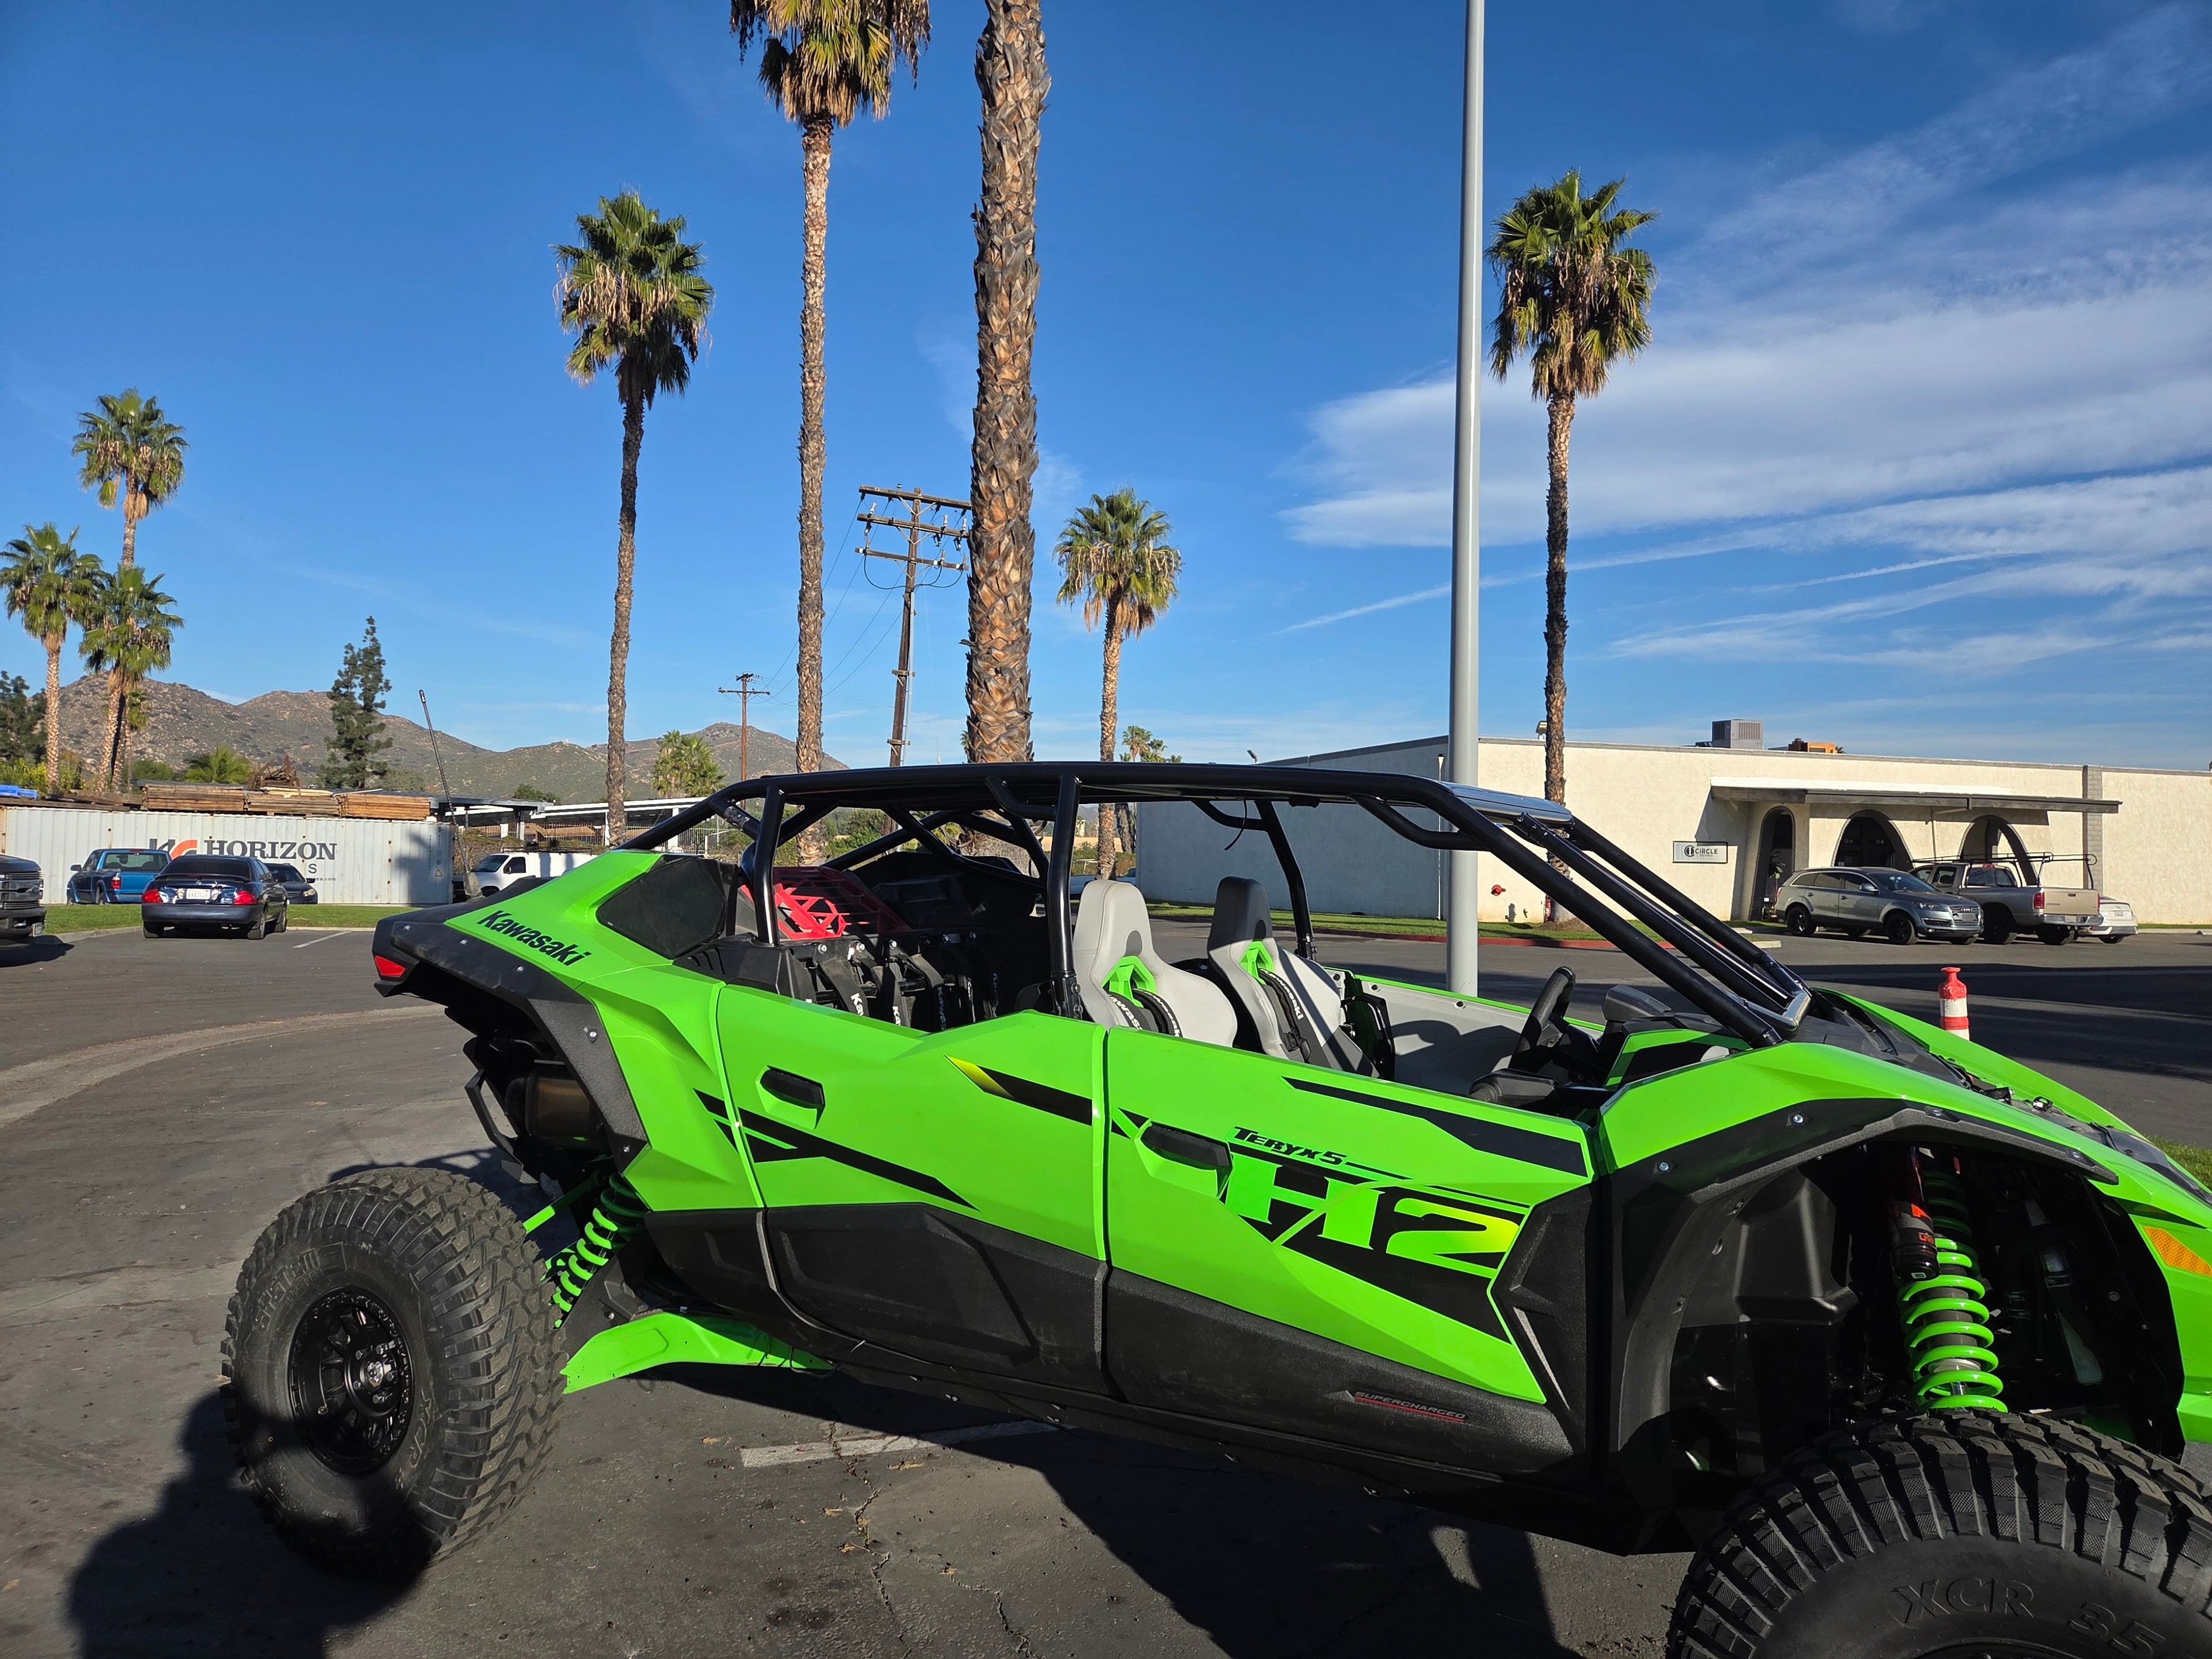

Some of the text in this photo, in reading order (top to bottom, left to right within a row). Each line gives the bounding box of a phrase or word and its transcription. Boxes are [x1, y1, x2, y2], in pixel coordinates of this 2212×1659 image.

[204, 839, 337, 860] HORIZON
[476, 910, 593, 967] Kawasaki
[1225, 1152, 1520, 1278] H2
[1354, 1391, 1466, 1419] SUPERCHARGED
[1889, 1577, 2166, 1657] XCR 35
